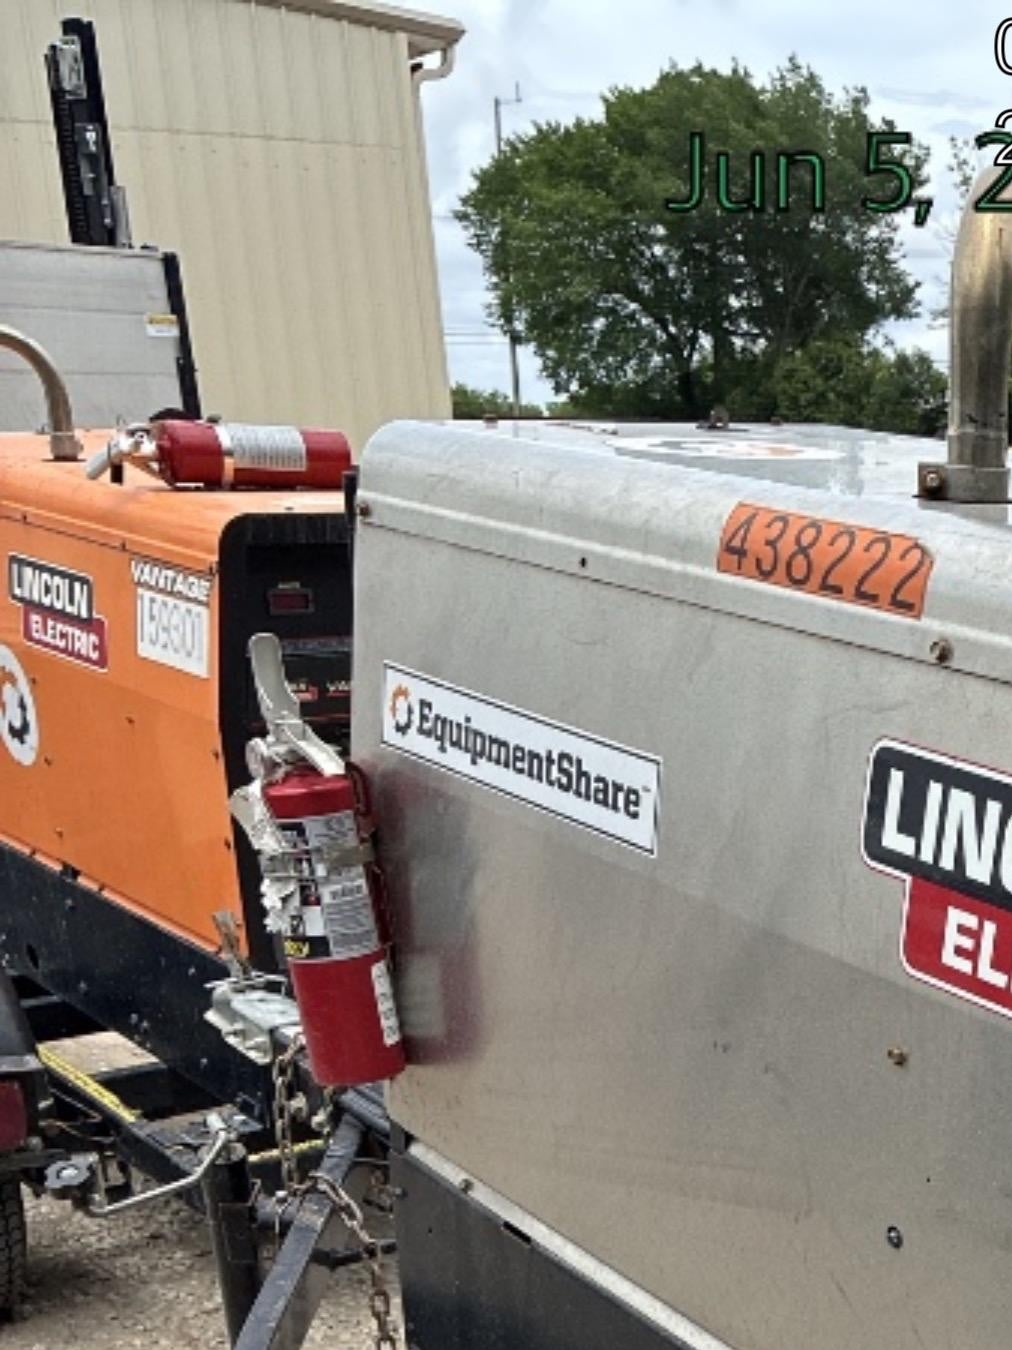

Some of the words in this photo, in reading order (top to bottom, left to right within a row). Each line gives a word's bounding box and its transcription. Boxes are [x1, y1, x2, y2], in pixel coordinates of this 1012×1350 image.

[130, 559, 211, 600] VANTAGE
[722, 512, 927, 610] 438222
[12, 562, 89, 618] LINCOLN
[29, 612, 99, 660] ELECTRIC
[416, 698, 641, 819] EquipmentShare
